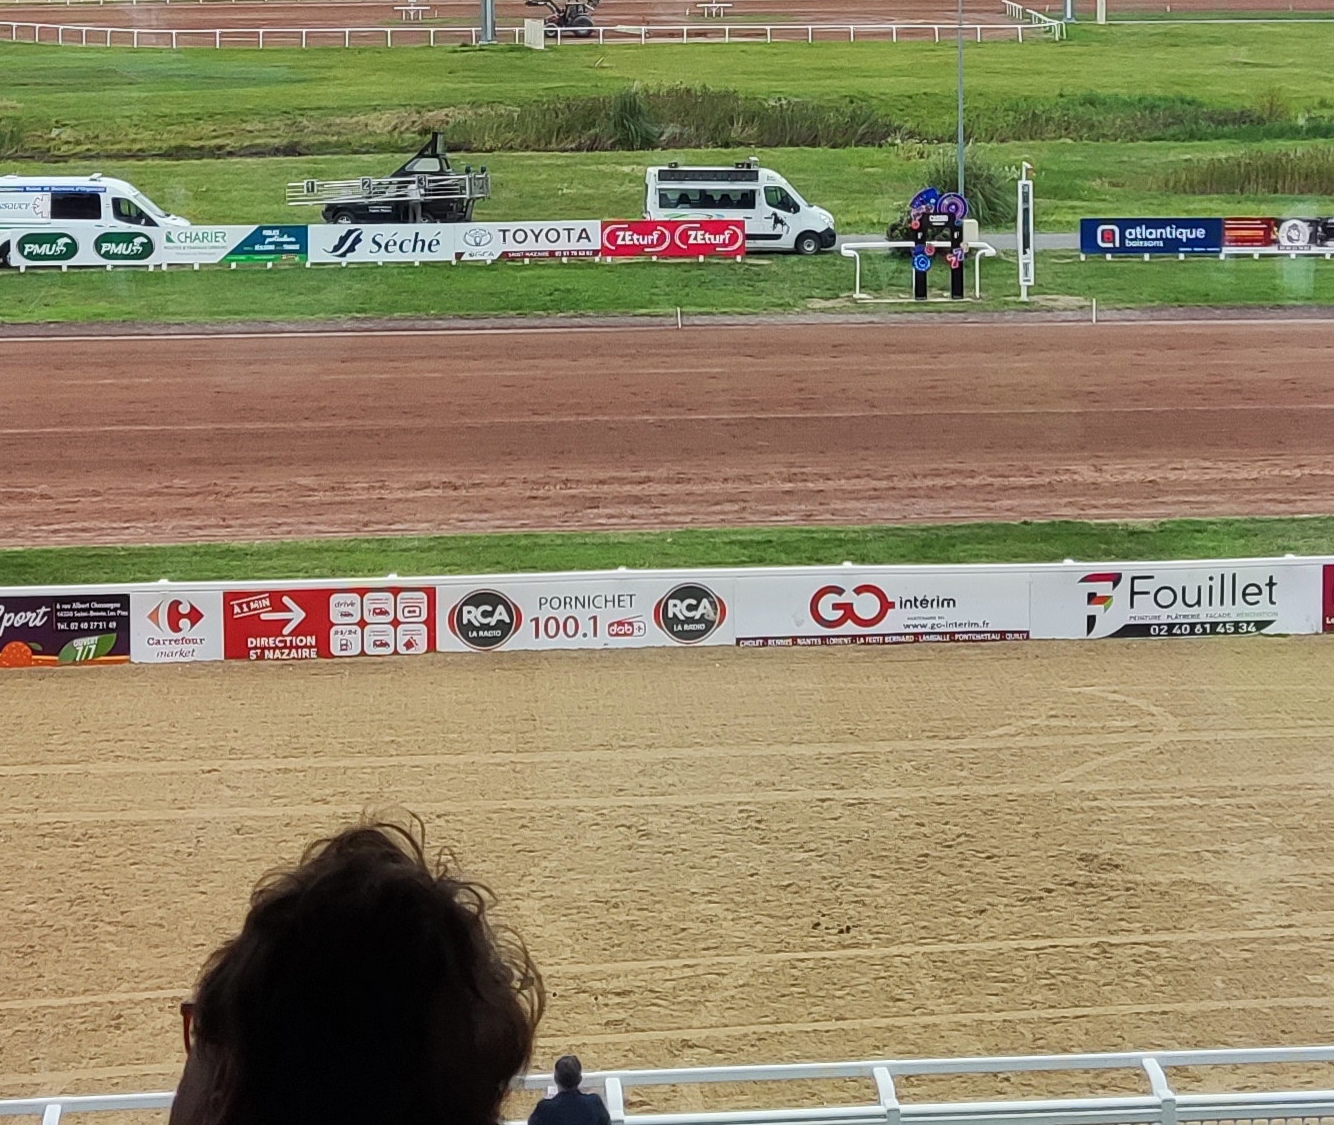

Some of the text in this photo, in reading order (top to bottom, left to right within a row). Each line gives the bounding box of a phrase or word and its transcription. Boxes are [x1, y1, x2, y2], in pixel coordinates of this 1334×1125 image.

[305, 181, 315, 193] 1
[362, 178, 371, 190] 2
[418, 176, 426, 188] 3
[177, 230, 227, 244] CHARIER
[497, 228, 592, 244] TOYOTA
[616, 230, 661, 245] ZEturf
[687, 230, 734, 245] ZEturf
[1125, 224, 1206, 243] atlantique
[100, 242, 134, 256] PMU
[369, 231, 441, 254] Séché
[1125, 239, 1164, 247] boissons
[23, 243, 57, 256] PMU
[1129, 572, 1278, 610] Fouillet
[250, 598, 270, 611] MIN
[334, 600, 356, 608] drive
[538, 594, 636, 611] PORNICHET
[667, 598, 714, 620] RCA
[899, 595, 957, 610] intérim
[462, 605, 510, 626] RCA
[529, 615, 598, 639] 100.1
[673, 623, 706, 632] LA RADIO
[903, 620, 990, 630] www.go-interim.fr
[1150, 622, 1257, 635] 02 40 61 45 34
[478, 629, 502, 637] RADIO
[73, 636, 99, 647] OUVERT
[146, 636, 206, 646] Carrefour
[248, 635, 316, 648] DIRECTION
[826, 637, 852, 645] LORIENT
[76, 644, 96, 662] 7/7
[156, 648, 197, 658] market
[264, 648, 317, 659] NAZAIRE
